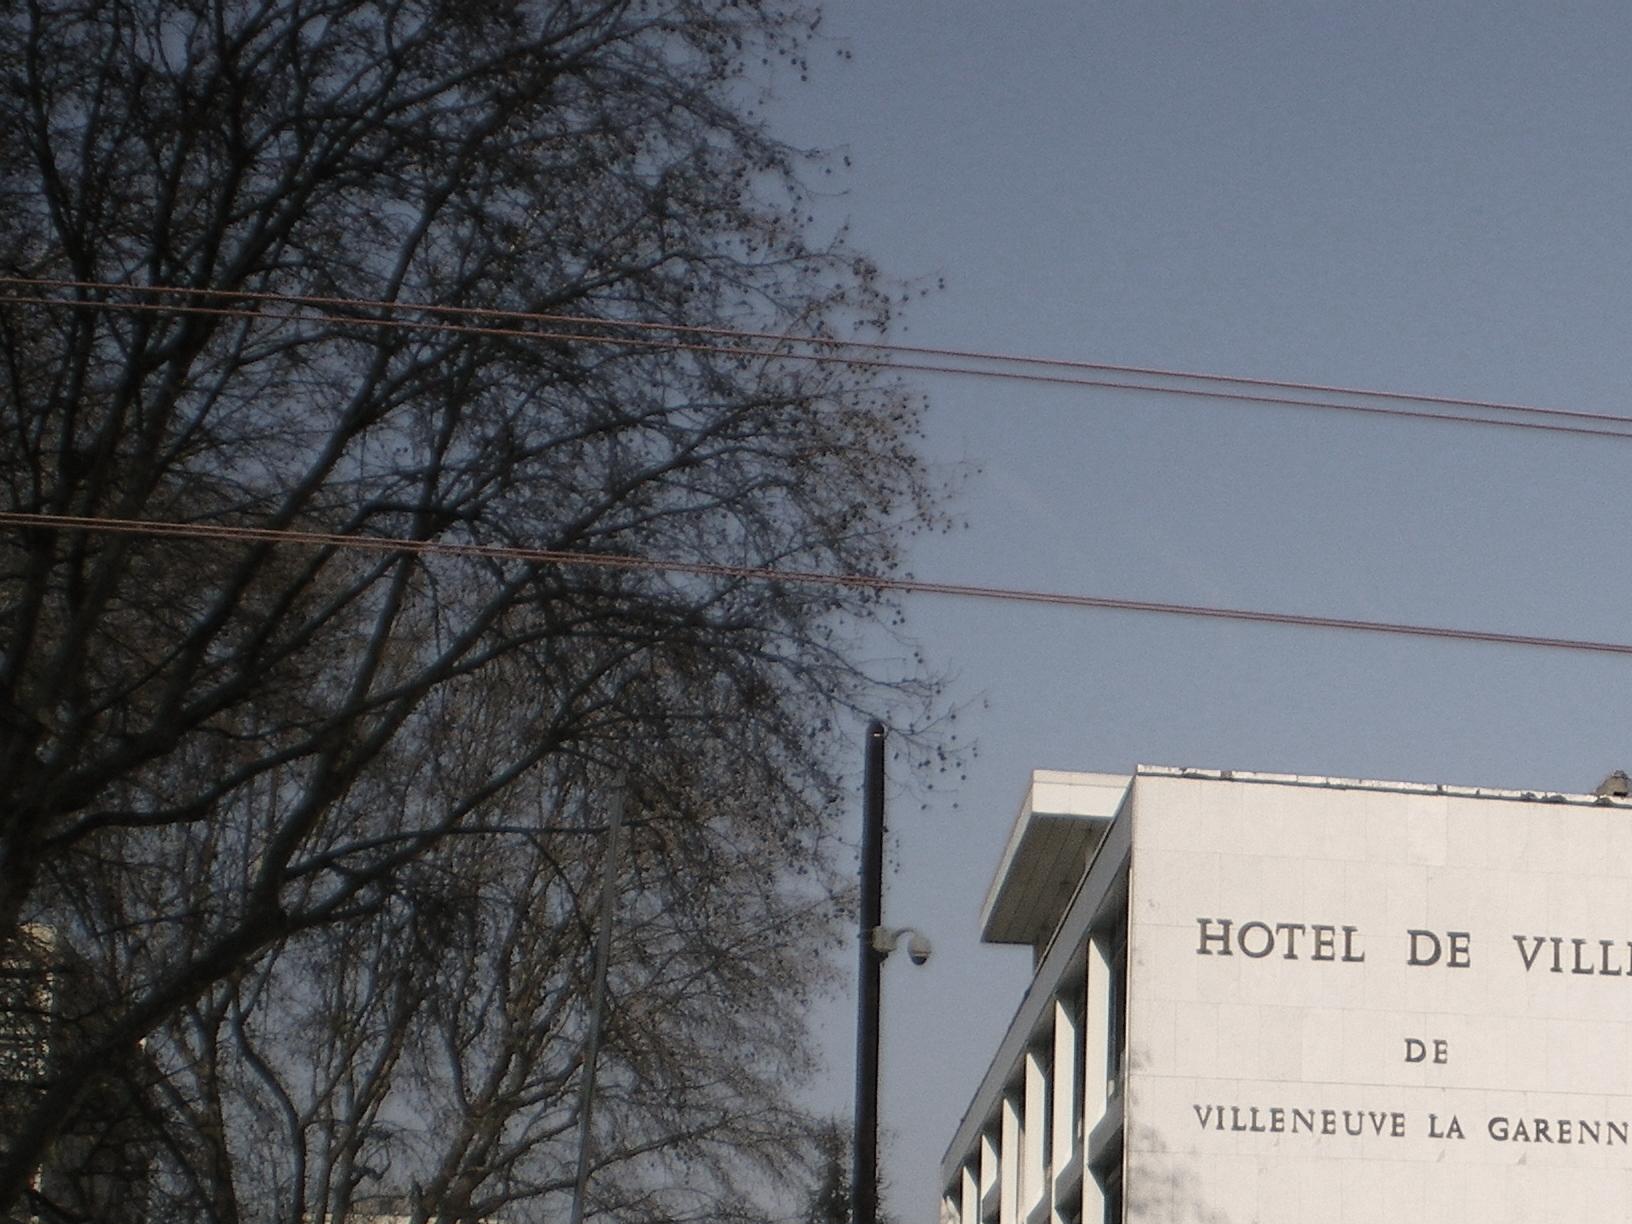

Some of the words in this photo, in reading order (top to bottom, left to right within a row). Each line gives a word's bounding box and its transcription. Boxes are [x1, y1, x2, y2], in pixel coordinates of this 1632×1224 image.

[1196, 918, 1366, 963] HOTEL
[1406, 929, 1471, 968] DE
[1404, 1038, 1448, 1065] DE
[1193, 1104, 1406, 1137] VILLENEUVE
[1428, 1113, 1465, 1140] LA
